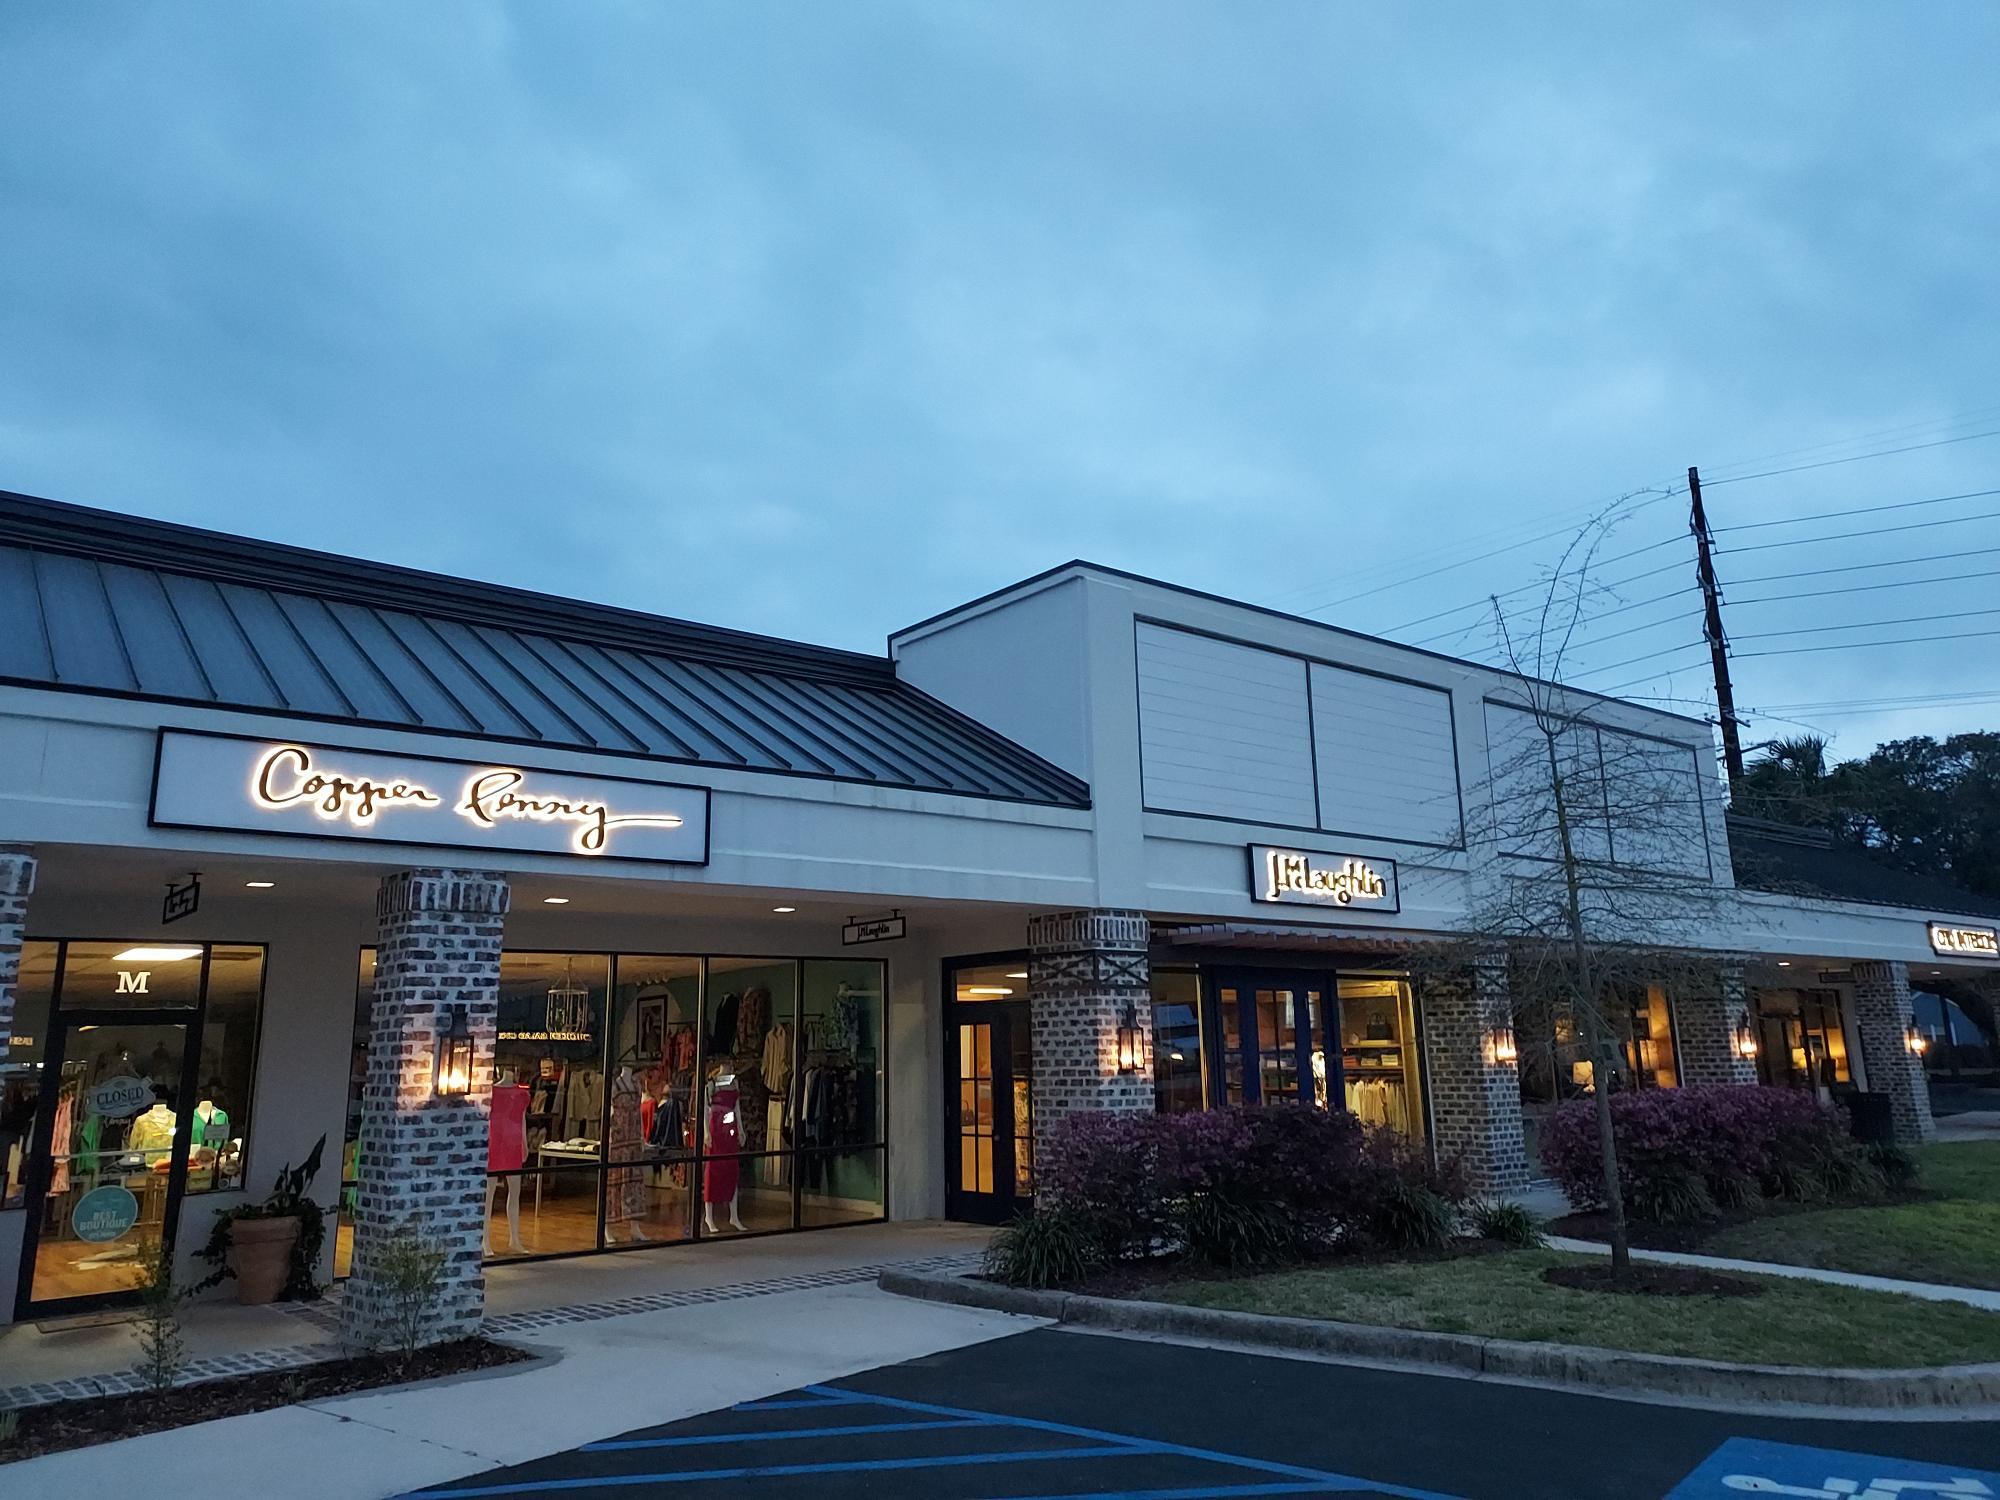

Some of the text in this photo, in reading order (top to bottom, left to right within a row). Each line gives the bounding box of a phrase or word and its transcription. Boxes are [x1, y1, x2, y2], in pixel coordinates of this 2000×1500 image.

[260, 747, 682, 850] Copper Penny
[115, 971, 151, 993] M
[96, 1086, 144, 1104] CLOSED
[79, 1217, 128, 1231] BOUTIQUE
[92, 1210, 117, 1221] BEST
